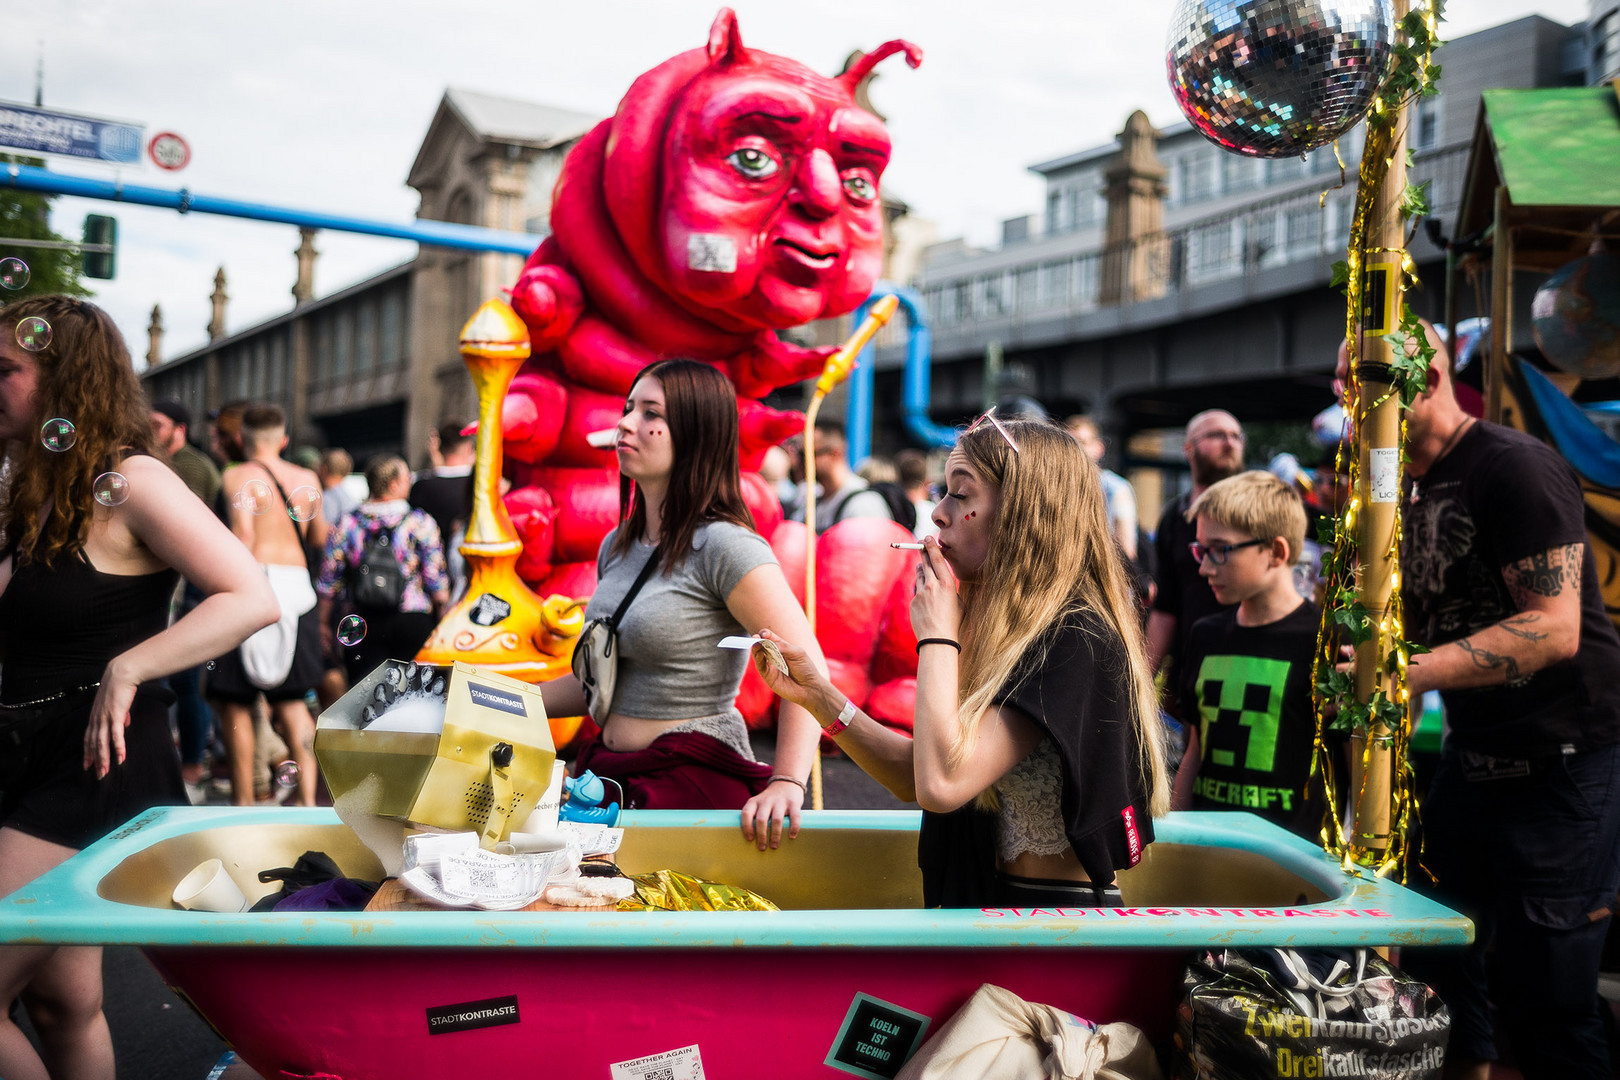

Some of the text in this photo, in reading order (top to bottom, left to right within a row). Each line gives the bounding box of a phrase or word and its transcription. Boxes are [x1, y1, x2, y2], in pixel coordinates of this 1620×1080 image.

[471, 689, 525, 710] STADTKONTRASTE
[1192, 776, 1294, 811] NECRAFT
[980, 907, 1393, 918] STADTKONTRASTE
[431, 1005, 516, 1026] STADTKONTRASTE
[869, 1017, 900, 1036] KOELN
[870, 1032, 888, 1046] IST
[618, 1055, 664, 1069] TOGETHER
[666, 1048, 693, 1058] AGAIN
[855, 1041, 891, 1061] TECHNO
[1277, 1043, 1444, 1078] Dreikaufstasche
